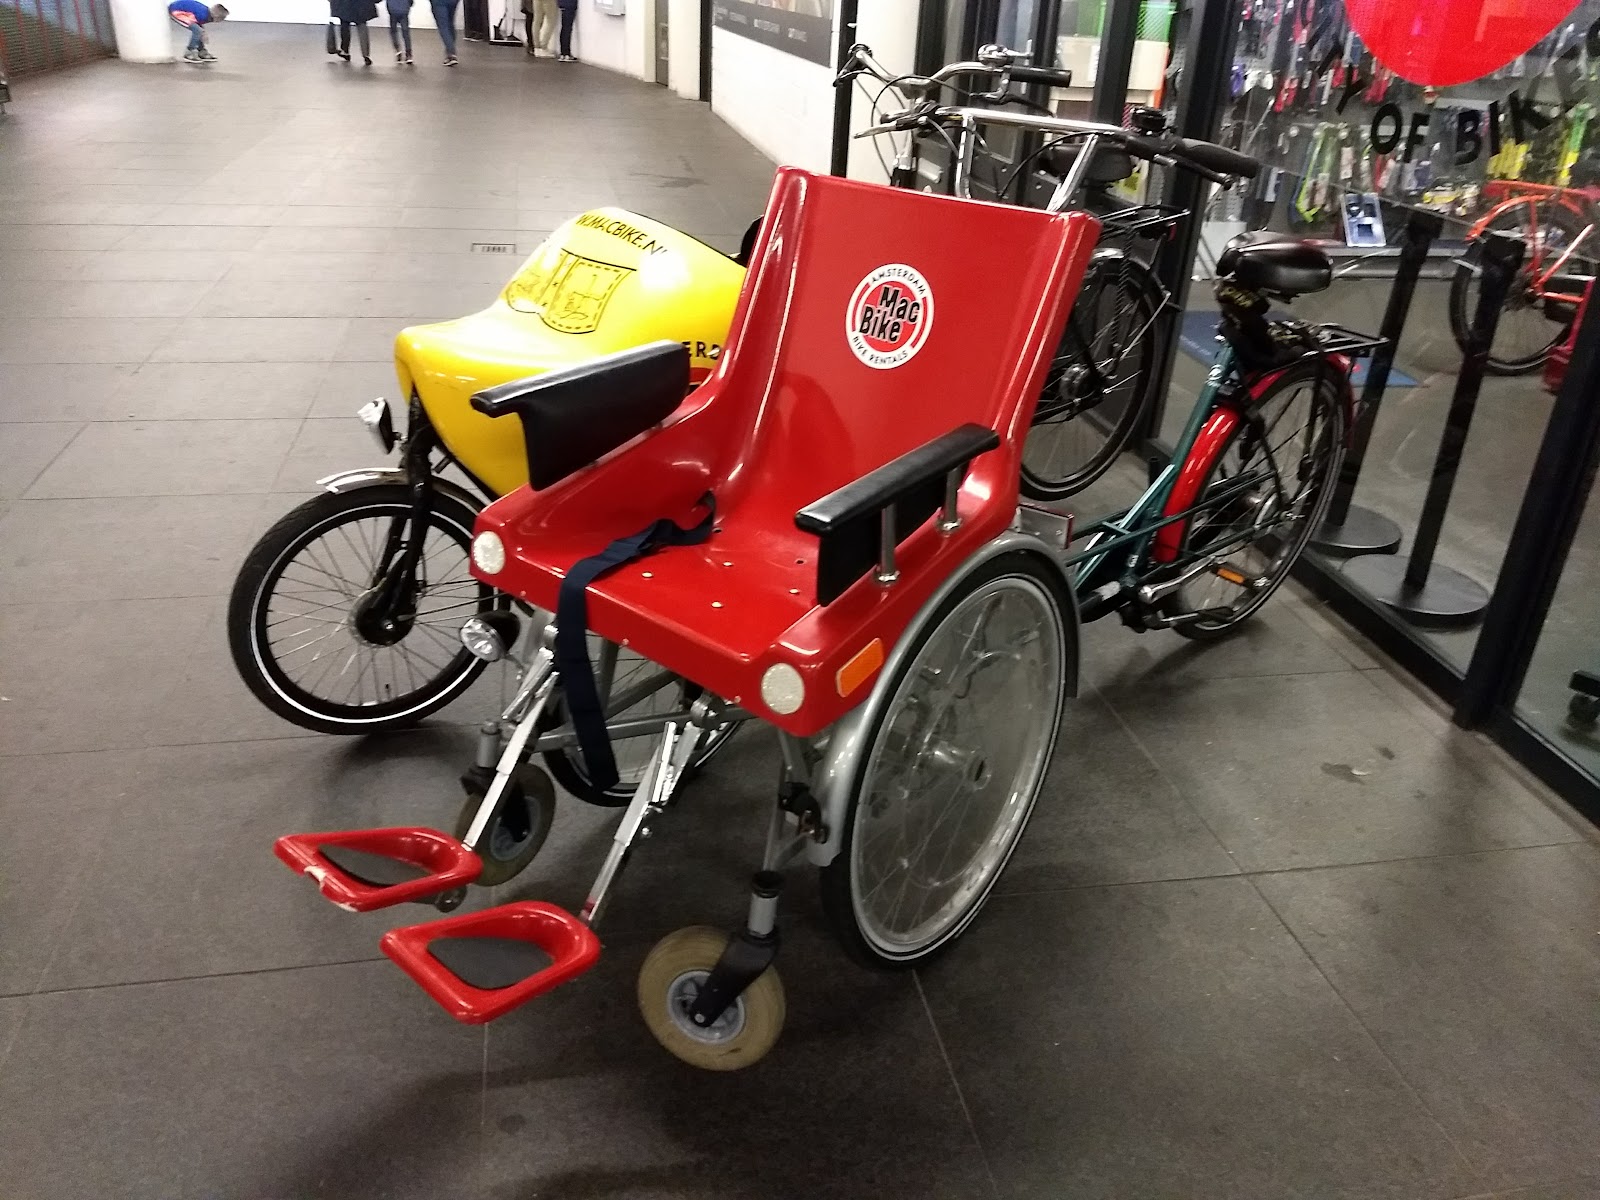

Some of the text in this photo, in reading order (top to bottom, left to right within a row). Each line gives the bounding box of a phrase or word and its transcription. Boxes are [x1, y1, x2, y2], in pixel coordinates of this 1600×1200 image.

[1371, 103, 1430, 163] OF
[871, 267, 926, 296] AMSTERDAM
[880, 286, 920, 323] Mac
[859, 306, 901, 342] Bike
[852, 336, 908, 364] BIKE RENTALS
